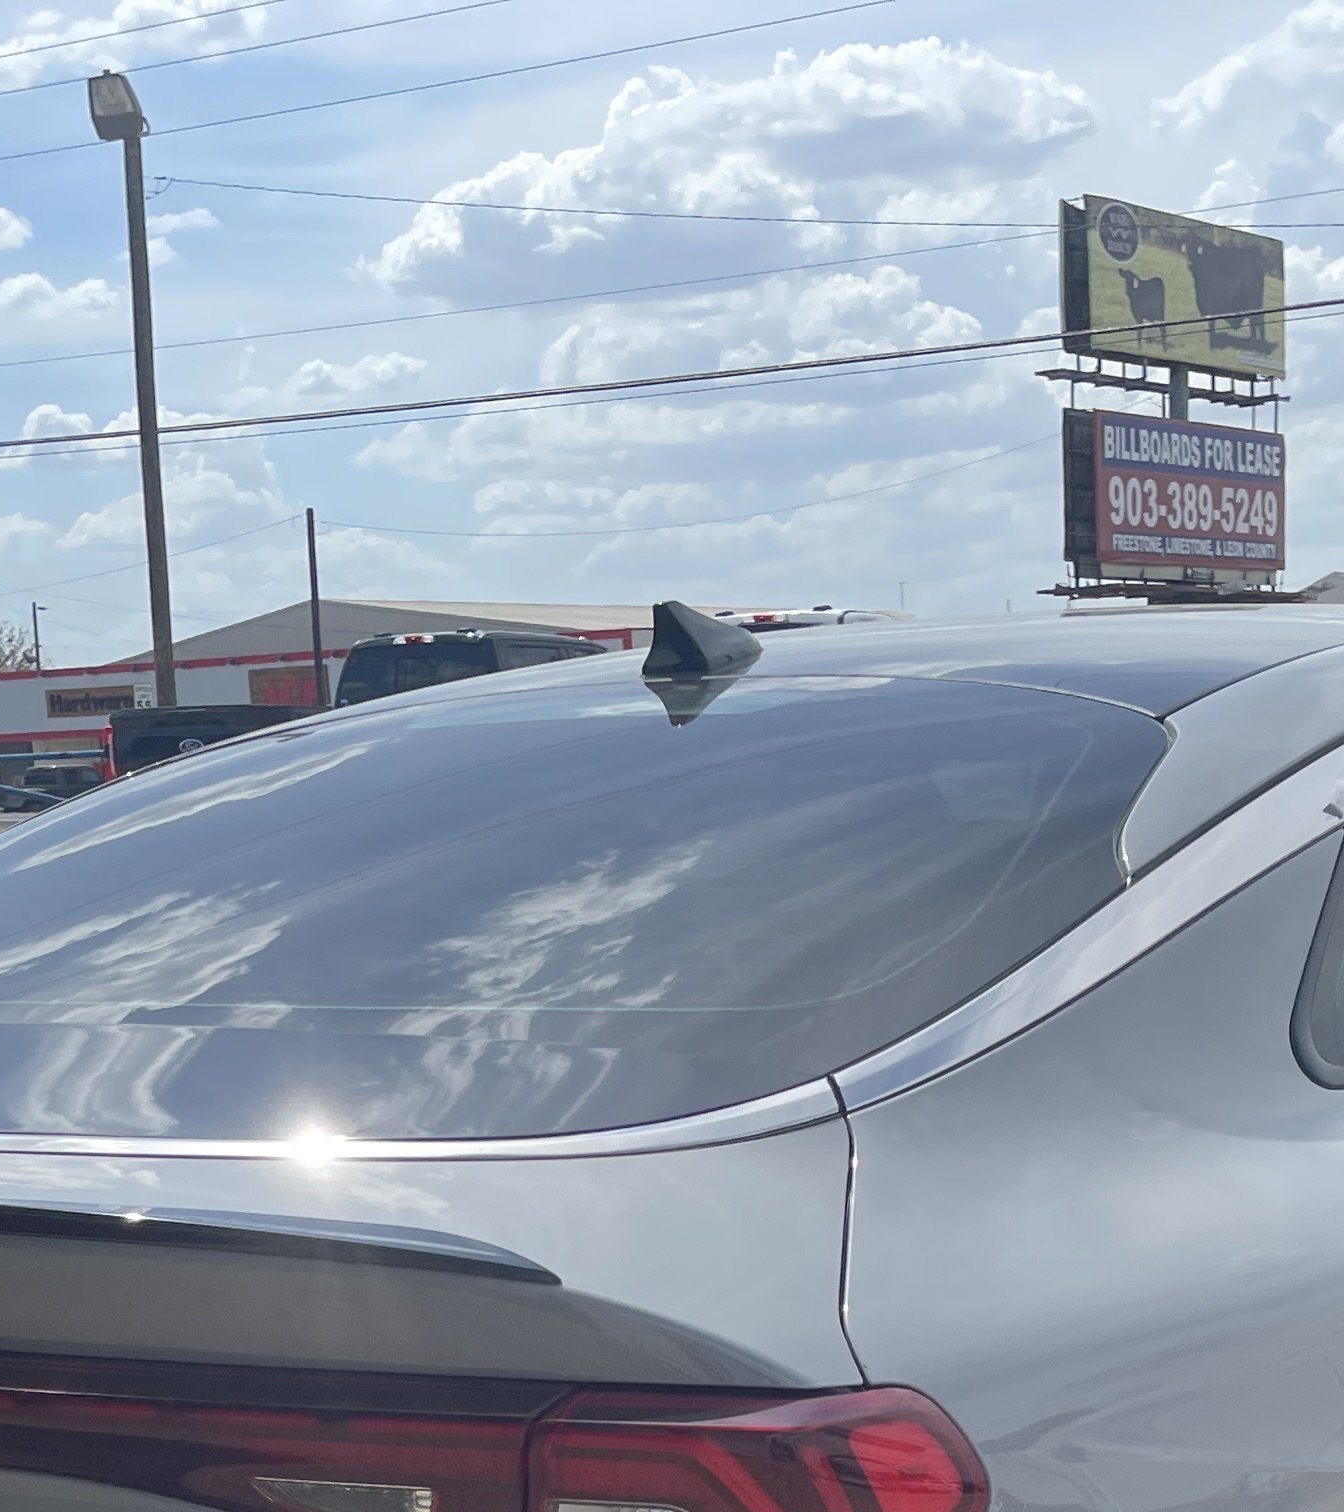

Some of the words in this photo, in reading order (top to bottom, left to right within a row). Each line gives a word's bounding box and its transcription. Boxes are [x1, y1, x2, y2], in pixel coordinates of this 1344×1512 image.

[1103, 425, 1201, 468] BILLBOARDS
[1204, 437, 1235, 473] FOR
[1237, 441, 1281, 477] LEASE
[1108, 476, 1278, 537] 903-389-5249
